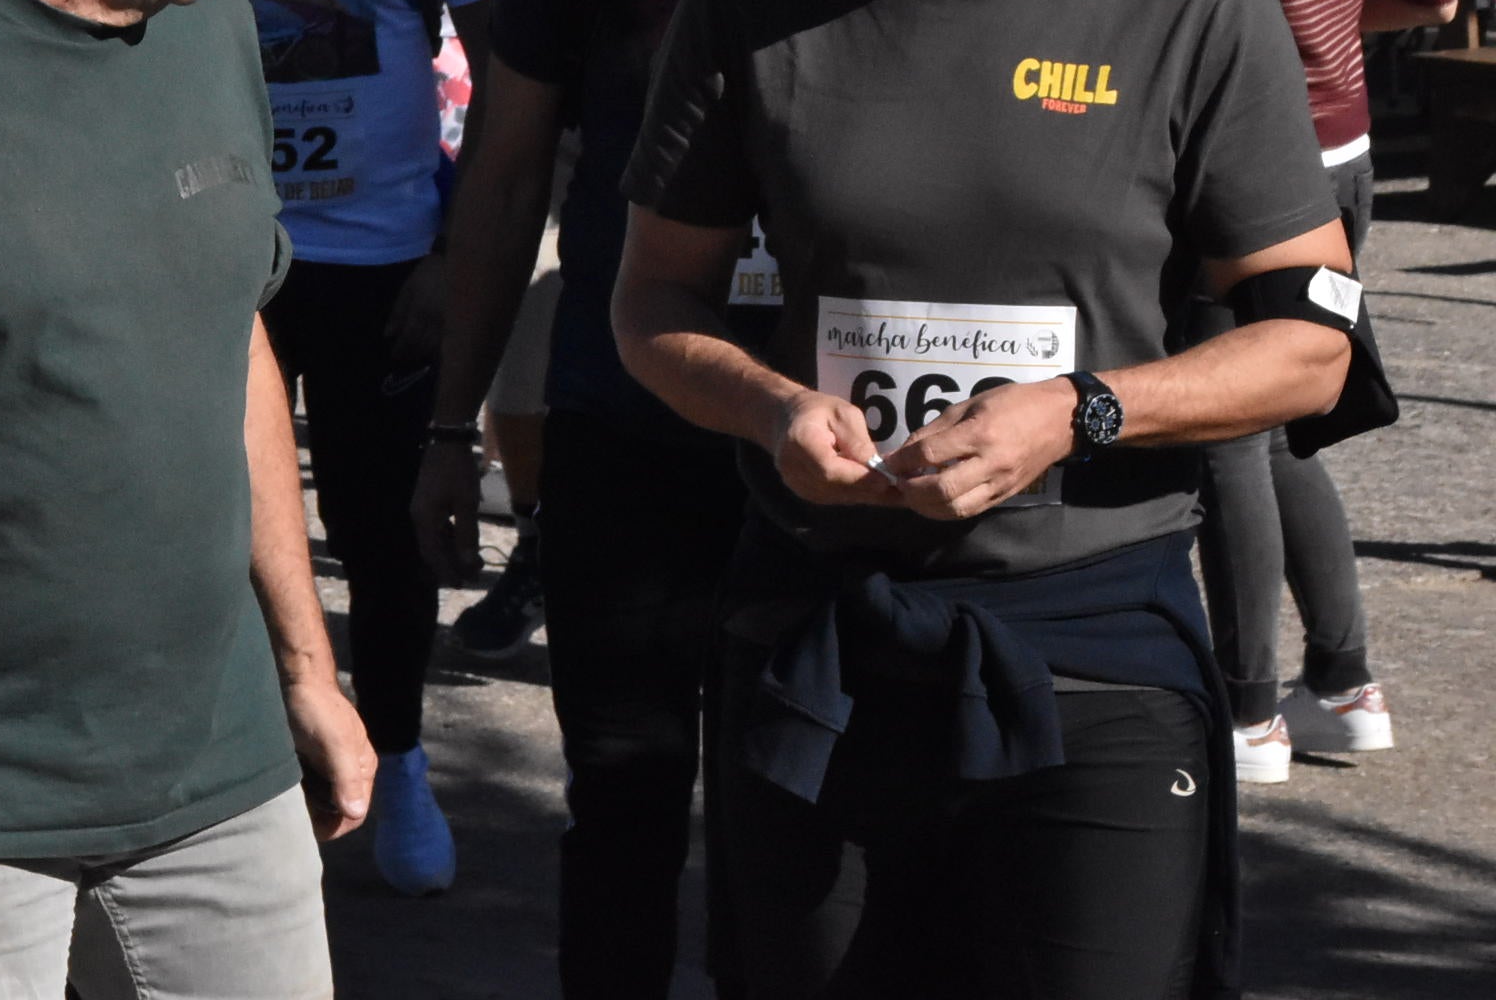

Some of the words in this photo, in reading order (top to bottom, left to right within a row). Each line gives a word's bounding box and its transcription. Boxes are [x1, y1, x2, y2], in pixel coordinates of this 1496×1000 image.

[1013, 58, 1118, 105] CHILL
[1042, 98, 1087, 114] FOREVER
[827, 321, 910, 355] marcha
[850, 369, 1019, 443] 66
